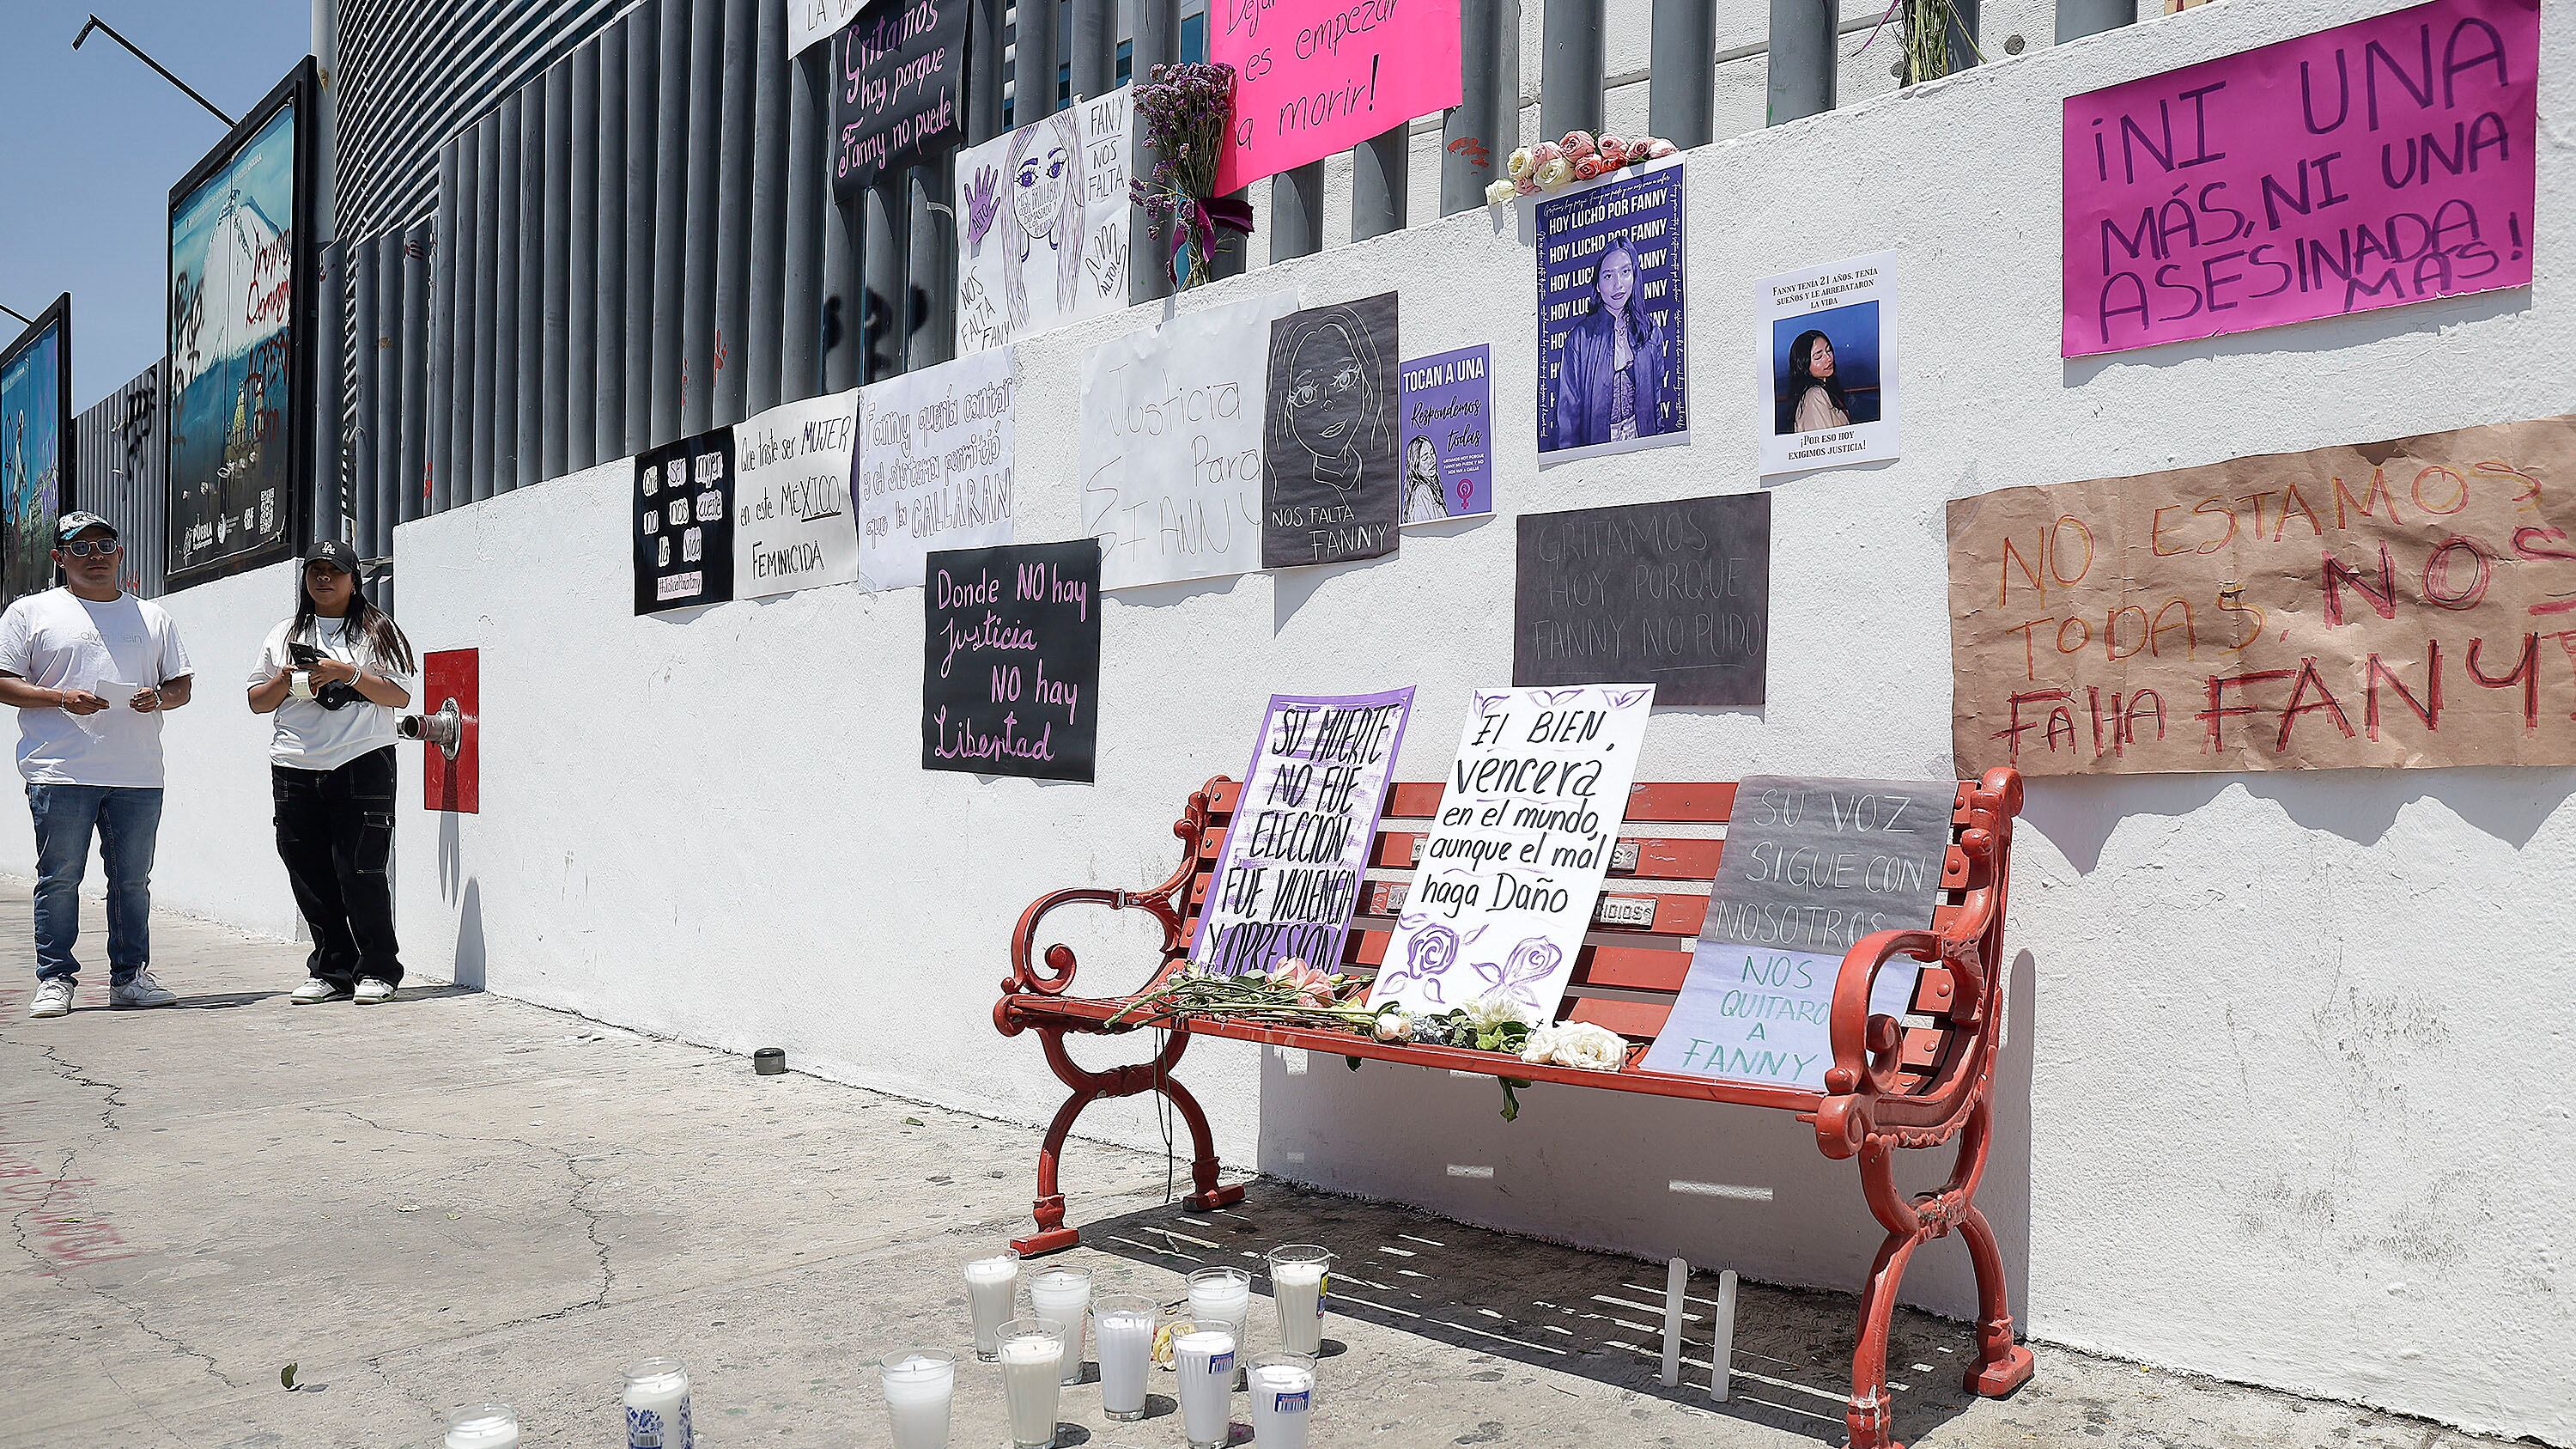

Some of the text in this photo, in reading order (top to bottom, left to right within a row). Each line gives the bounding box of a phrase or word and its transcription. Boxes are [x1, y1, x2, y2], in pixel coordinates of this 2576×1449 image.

[845, 0, 939, 104] Gritamos
[1245, 47, 1273, 81] es
[861, 46, 945, 114] hoy porque
[1237, 53, 1380, 150] a morir!
[2091, 16, 2509, 185] ¡NI UNA
[838, 86, 951, 179] Fanny no puede
[1091, 94, 1126, 137] FANY
[1093, 140, 1117, 169] NOS
[1088, 164, 1126, 202] FALTA
[2101, 111, 2509, 277] MÁS, NI UNA
[972, 204, 989, 234] ALTO
[1549, 214, 1570, 234] HOY
[1571, 204, 1605, 229] LUCHO
[1607, 199, 1629, 220] POR
[1631, 188, 1668, 213] FANNY
[1549, 244, 1570, 265] HOY
[1571, 234, 1605, 259] LUCHO
[1631, 217, 1668, 243] FANNY
[960, 266, 984, 310] NOS
[1549, 272, 1570, 293] HOY
[1776, 279, 1874, 306] SUEÑOS Y LE ARREBATARON
[1797, 279, 1819, 291] TENÍA
[1820, 275, 1830, 286] 21
[1855, 267, 1878, 279] TENÍA
[2099, 198, 2479, 344] ASESINADA
[960, 296, 996, 352] FALTA
[1550, 301, 1571, 321] HOY
[1820, 297, 1838, 307] VIDA
[981, 320, 1011, 351] FANY
[1403, 356, 1485, 393] TOCAN A UNA
[1109, 363, 1242, 436] Justicia
[1411, 396, 1482, 429] Respondemos
[741, 416, 852, 472] Que triste ser MUJER
[866, 402, 911, 458] Fanny
[1447, 424, 1483, 452] todas
[1788, 440, 1867, 460] EXIGIMOS JUSTICIA!
[1821, 433, 1837, 442] ESO
[1838, 431, 1855, 441] HOY
[669, 459, 685, 484] ser
[872, 461, 886, 496] el
[1191, 435, 1261, 487] Para
[646, 512, 658, 533] no
[671, 502, 689, 523] nos
[740, 475, 841, 527] en este MÉXICO
[866, 467, 1012, 550] que la CALLARAN
[1272, 505, 1355, 527] NOS FALTA
[321, 541, 336, 555] LA
[1308, 522, 1388, 561] FANNY
[1538, 508, 1709, 570] GRITAMOS
[2000, 460, 2543, 608] NO ESTAMOS
[938, 563, 1088, 623] Donde NO hay
[1550, 557, 1746, 608] HOY PORQUE
[2323, 525, 2576, 630] NOS
[939, 609, 1038, 679] Justicia
[1532, 612, 1762, 660] FANNY NO PUDO
[991, 658, 1078, 726] NO hay
[933, 704, 1056, 762] Libertad
[1272, 703, 1400, 764] SU MUERTE
[1527, 709, 1616, 752] BIEN,
[1267, 764, 1363, 814] NO FUE
[1753, 788, 1915, 832] SU VOZ
[1443, 799, 1601, 841] en el mundo,
[1430, 836, 1513, 871] aunque
[1519, 832, 1546, 864] el
[1552, 833, 1607, 869] mal
[1745, 842, 1927, 894] SIGUE CON
[1221, 867, 1268, 919] FUE
[1420, 873, 1569, 917] haga Daño
[1206, 923, 1225, 975] Y
[1740, 955, 1814, 989] NOS
[1720, 989, 1830, 1026] QUITARO
[1746, 1022, 1766, 1041] A
[1682, 1037, 1820, 1081] FANNY
